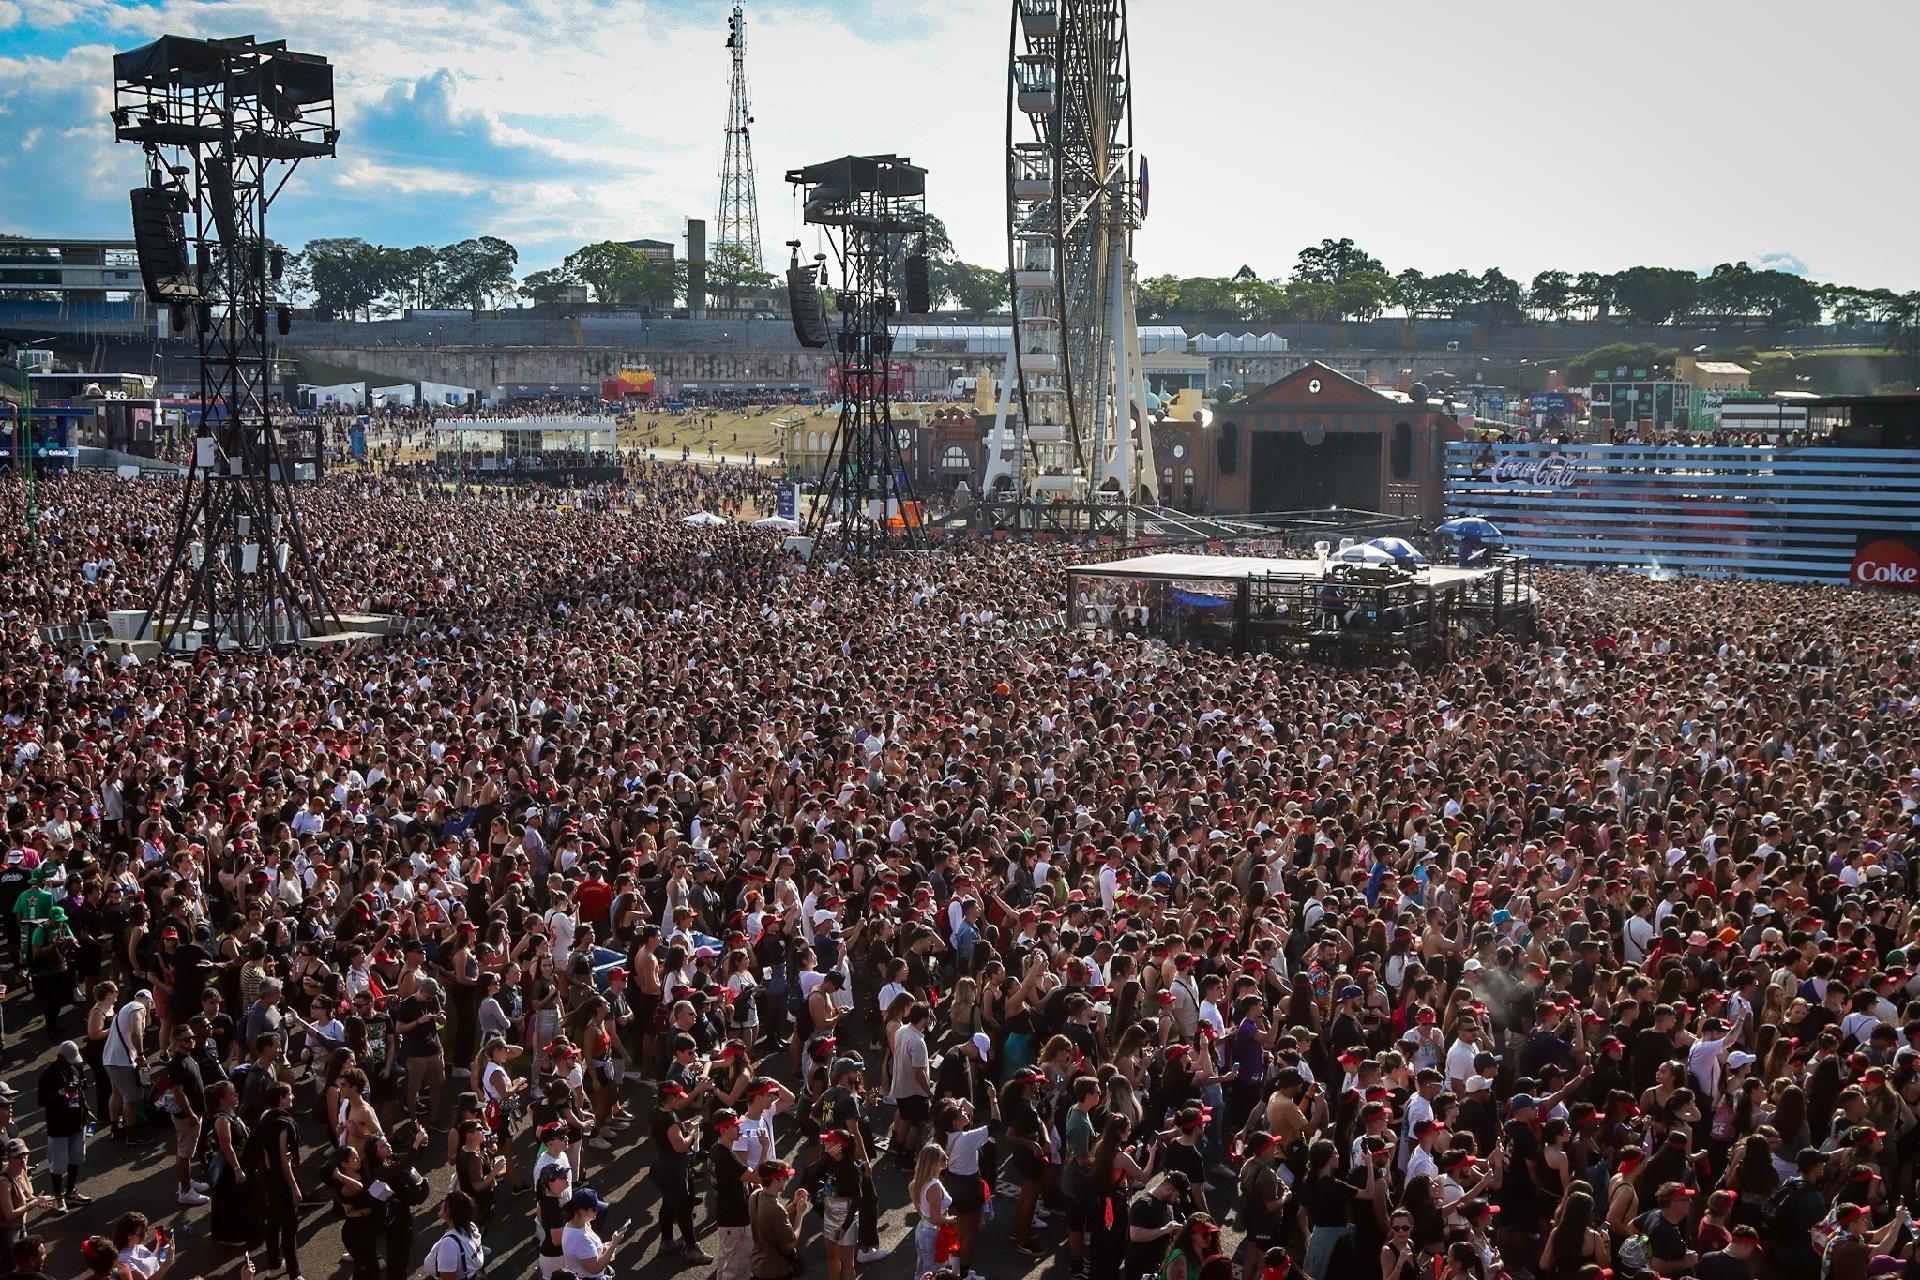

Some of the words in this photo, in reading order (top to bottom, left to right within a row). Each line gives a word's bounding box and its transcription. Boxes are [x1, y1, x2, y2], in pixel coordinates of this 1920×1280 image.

[112, 391, 128, 399] 5G
[1701, 400, 1722, 408] Tride
[1857, 561, 1918, 583] Coke
